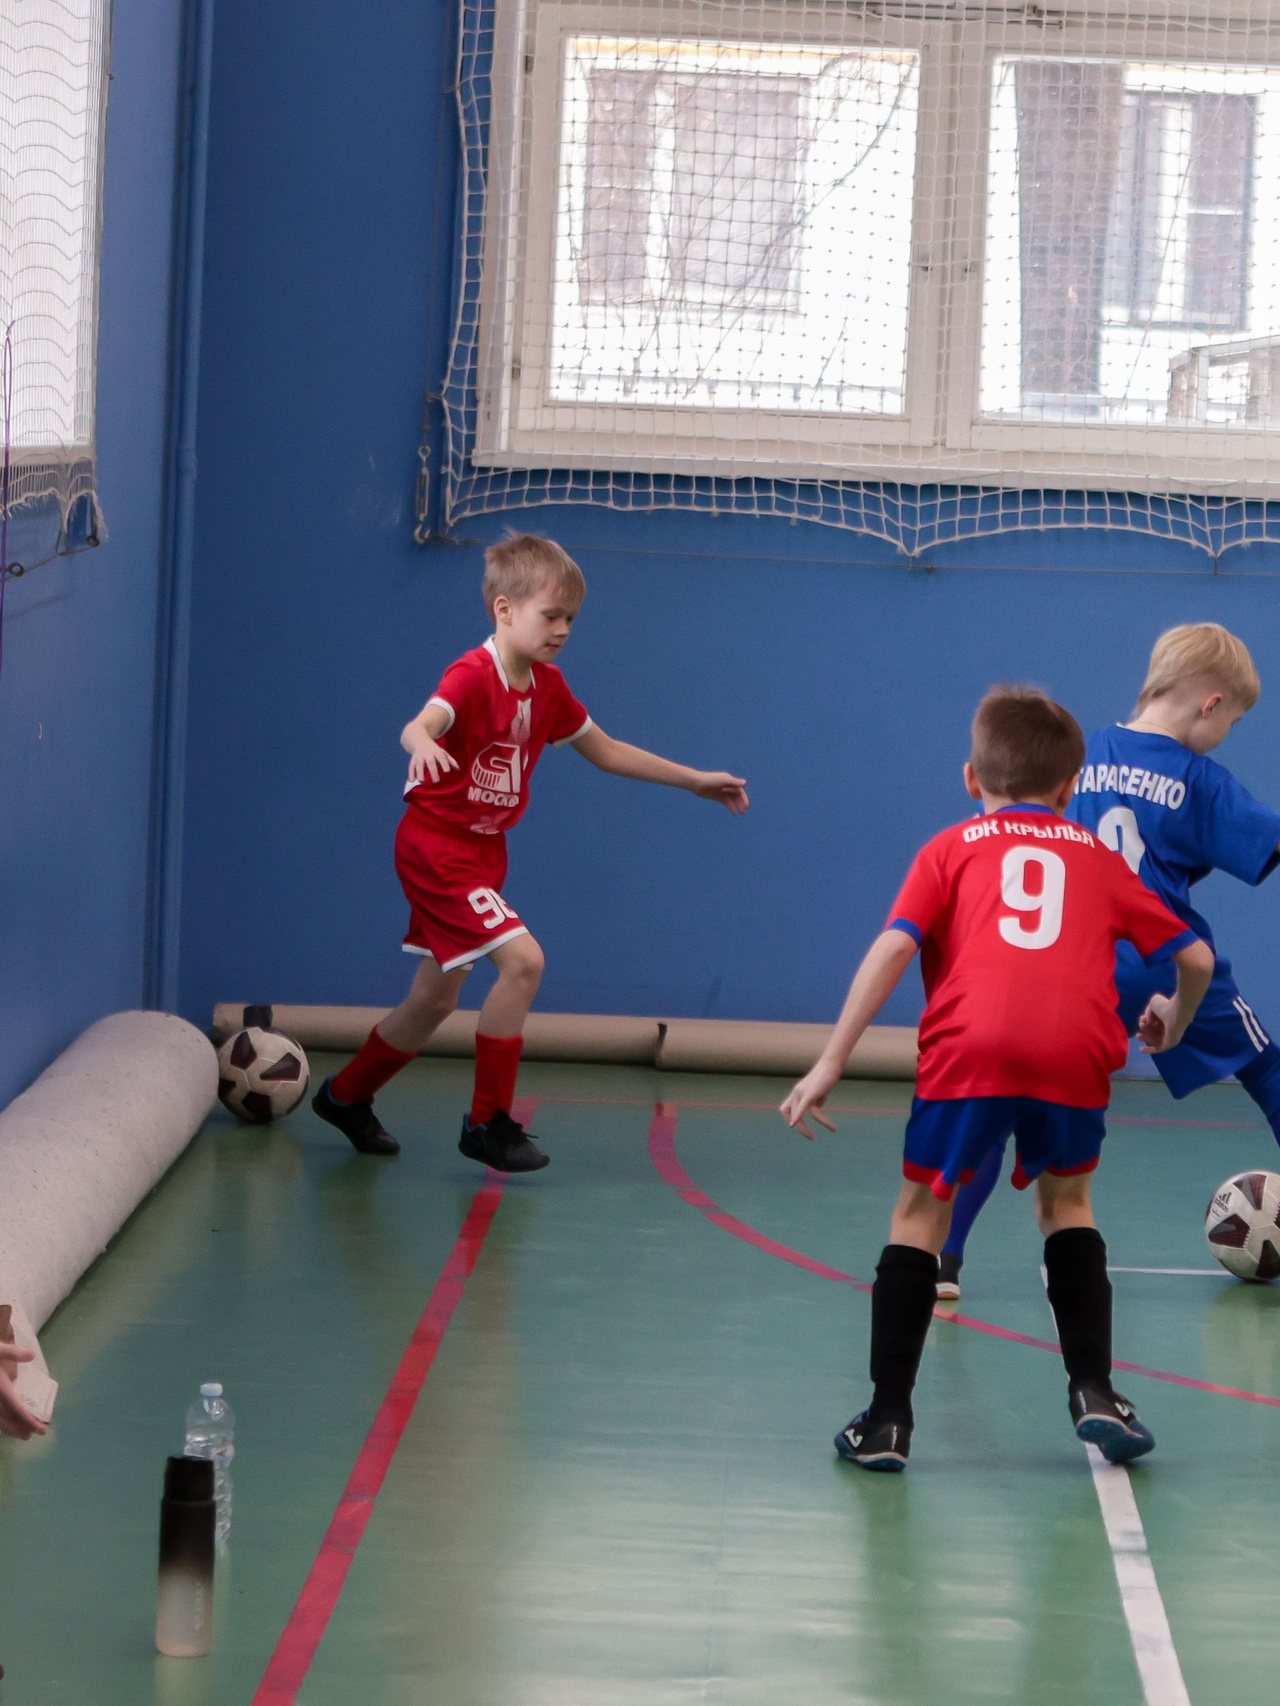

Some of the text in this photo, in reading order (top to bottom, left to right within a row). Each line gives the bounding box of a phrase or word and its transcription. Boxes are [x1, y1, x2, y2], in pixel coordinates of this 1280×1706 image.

[467, 786, 520, 808] МОСКВ
[963, 820, 1096, 849] ФК КРЫЛЬЯ
[998, 845, 1067, 950] 9
